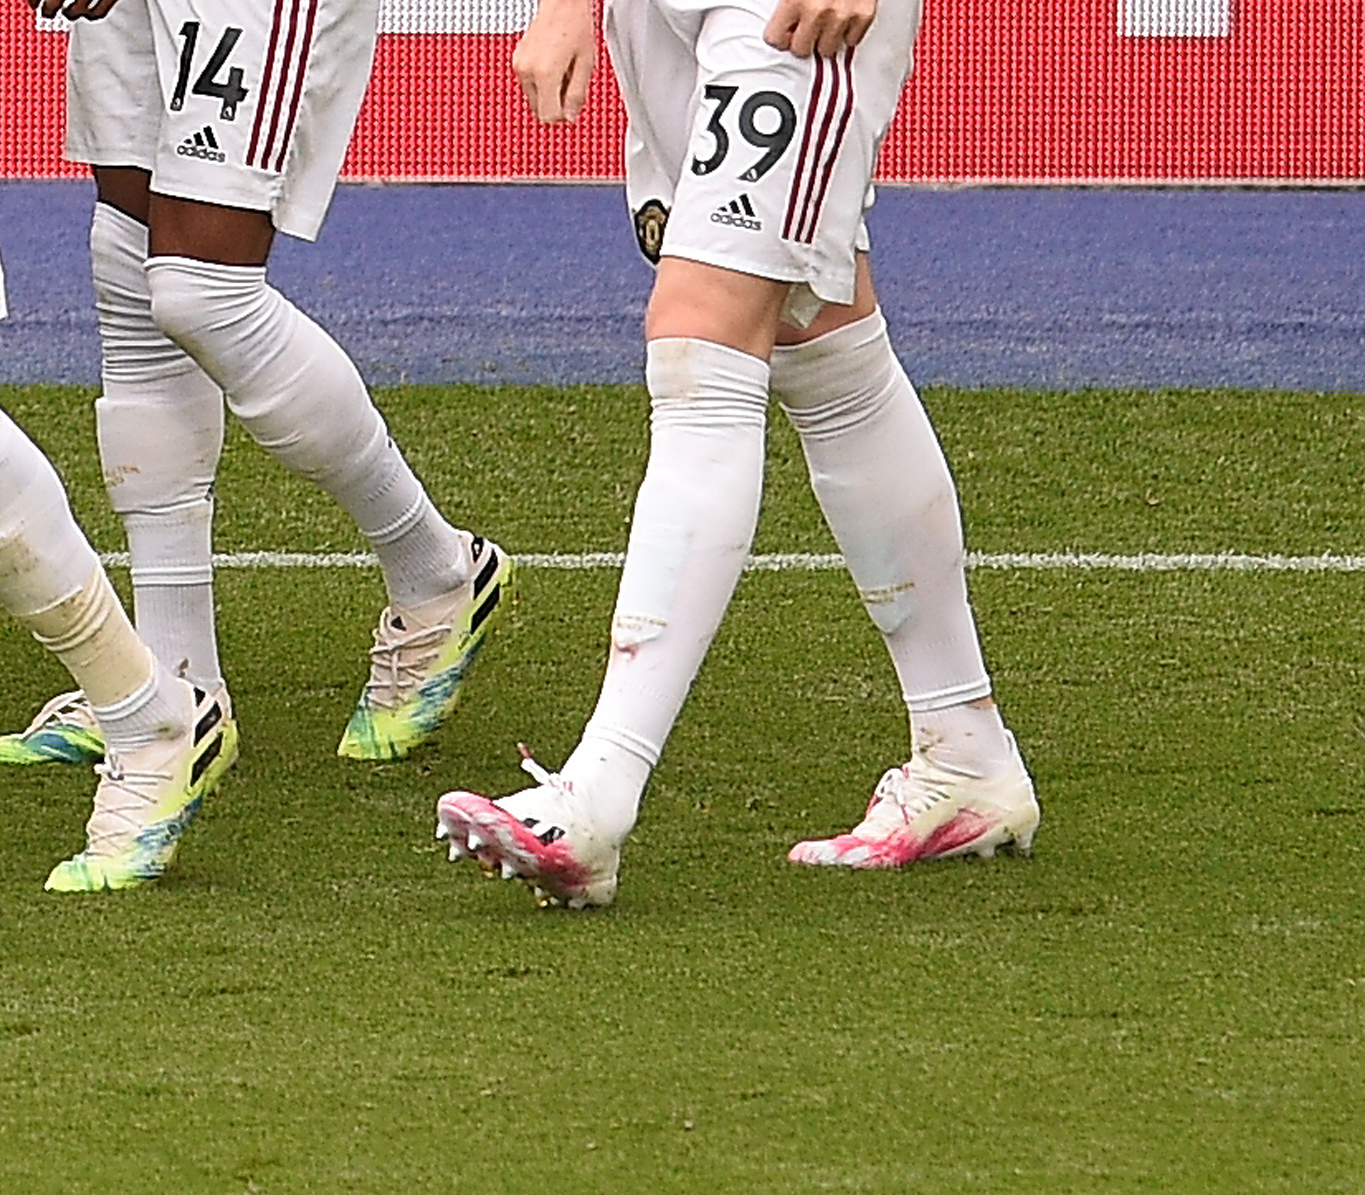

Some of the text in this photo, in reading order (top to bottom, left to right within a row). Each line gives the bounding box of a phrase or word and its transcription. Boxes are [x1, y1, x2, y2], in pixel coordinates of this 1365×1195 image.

[169, 20, 250, 122] 14
[177, 145, 226, 163] adidas
[690, 83, 798, 183] 39
[710, 212, 762, 231] adidas
